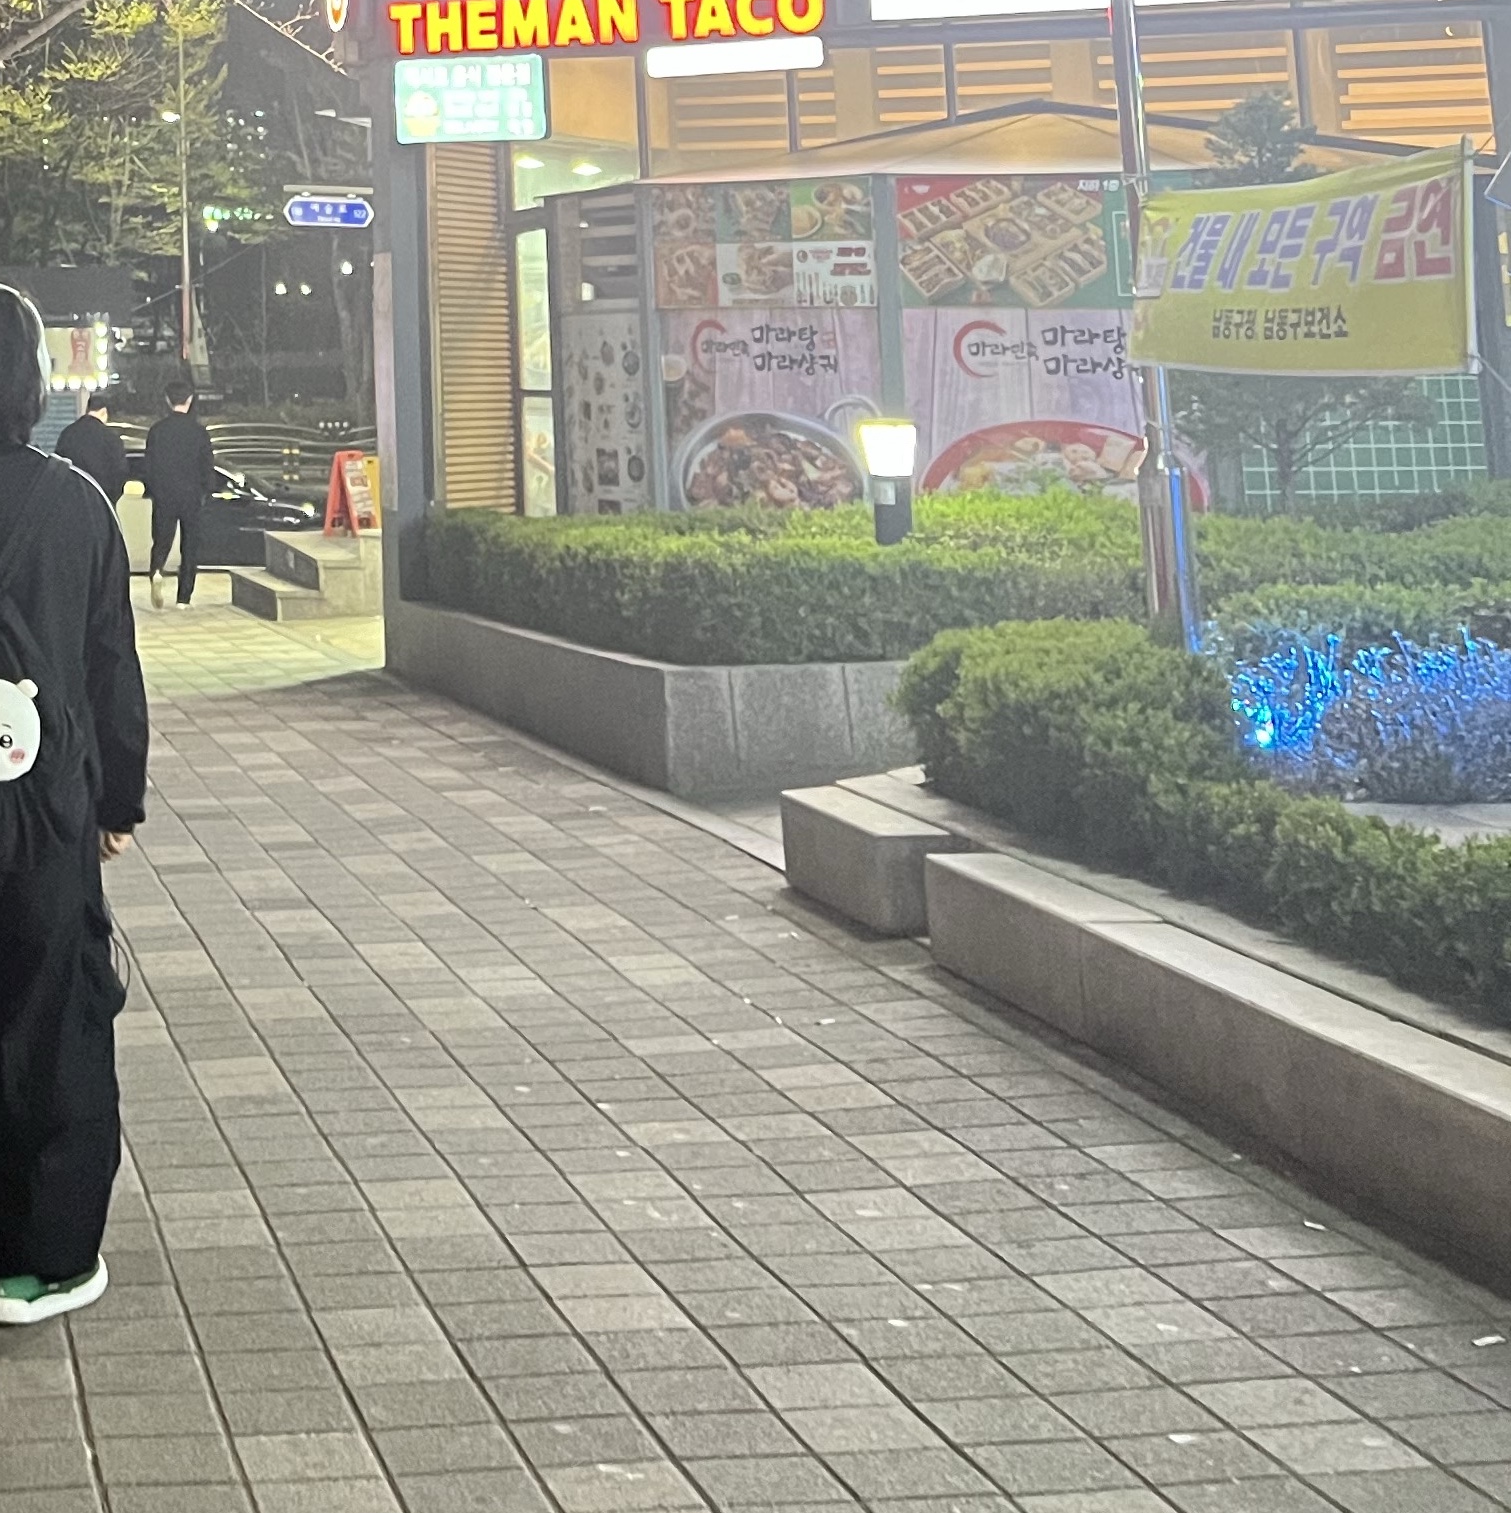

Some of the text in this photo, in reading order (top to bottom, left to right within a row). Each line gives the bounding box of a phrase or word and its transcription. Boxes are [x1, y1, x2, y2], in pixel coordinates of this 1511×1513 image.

[1247, 205, 1317, 289] 모든
[1311, 194, 1380, 287] 구역
[1374, 178, 1455, 280] 금연
[751, 324, 819, 351] 마라탕
[1264, 305, 1349, 340] 남동구보건소
[1042, 325, 1127, 355] 마라탕
[1044, 354, 1139, 380] 마라샹
